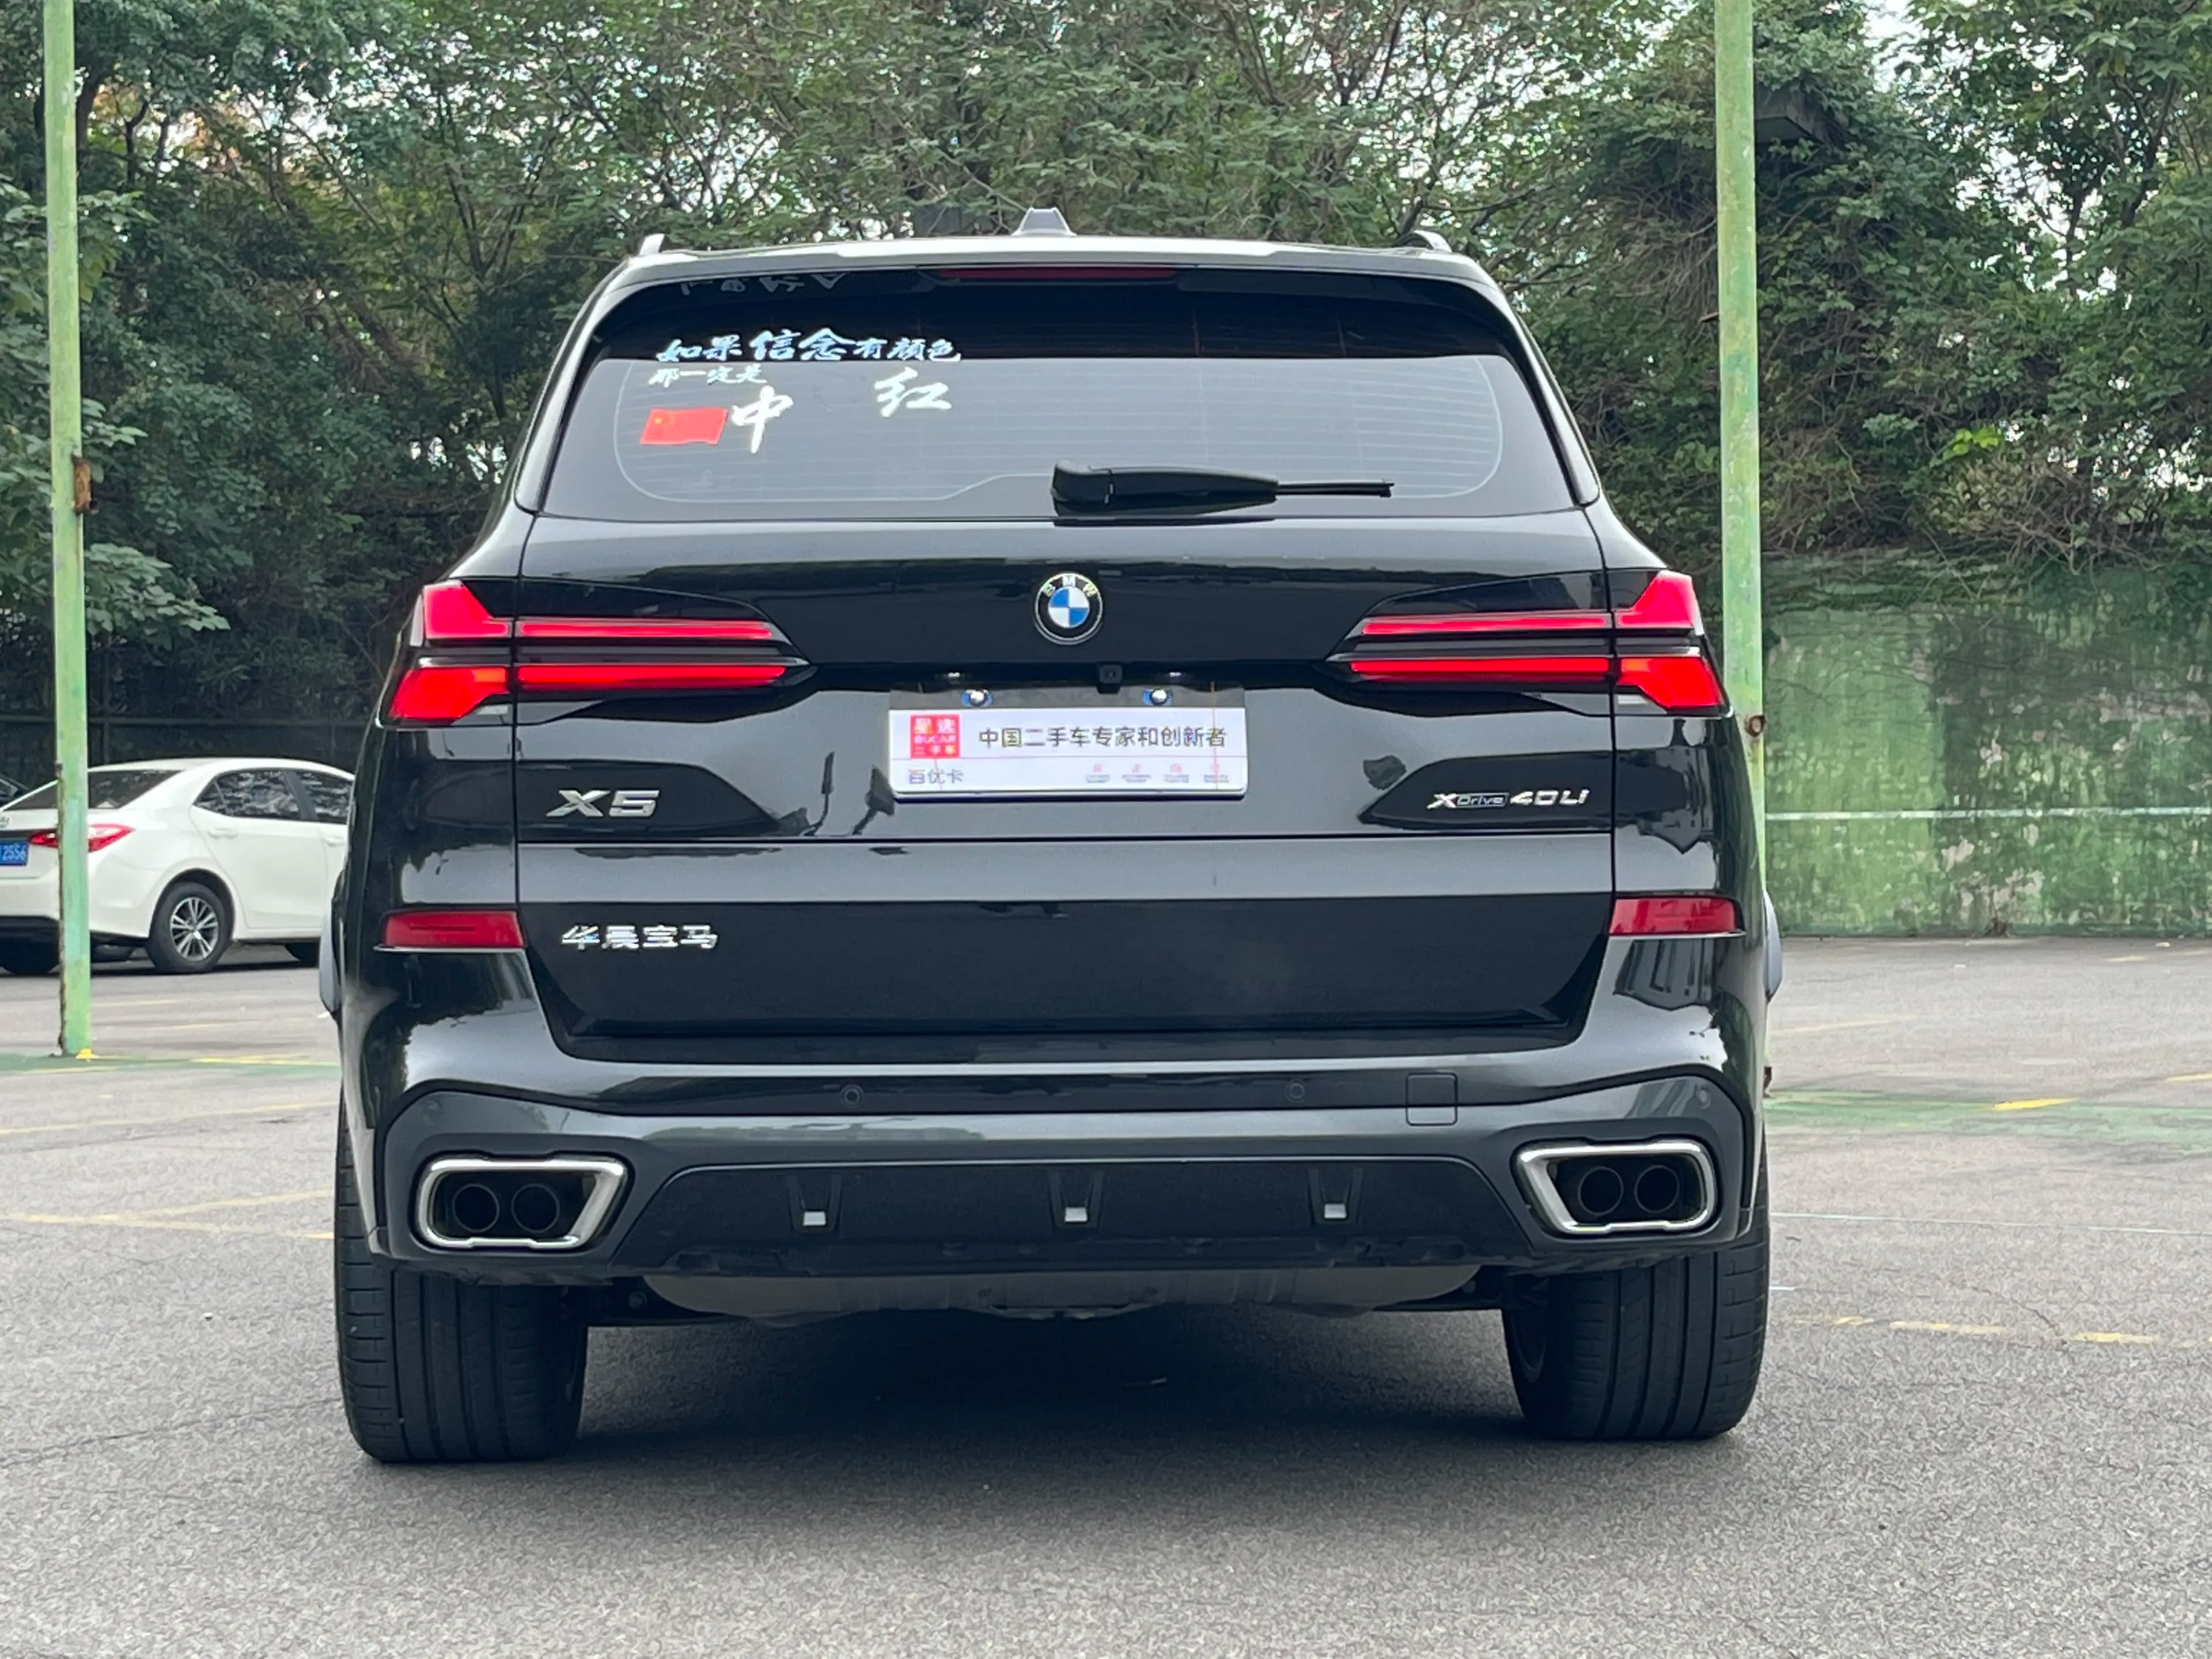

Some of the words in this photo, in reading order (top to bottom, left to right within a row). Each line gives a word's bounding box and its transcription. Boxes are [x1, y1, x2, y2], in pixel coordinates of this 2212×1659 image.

[656, 328, 961, 362] 如果信念有颜色
[730, 385, 794, 453] 中
[874, 366, 952, 418] 红
[1041, 574, 1098, 597] BMW
[979, 726, 1227, 749] 中国二手车专家和创新者
[908, 768, 964, 785] 百优卡
[546, 789, 660, 817] X5
[562, 925, 718, 950] 华晨宝马
